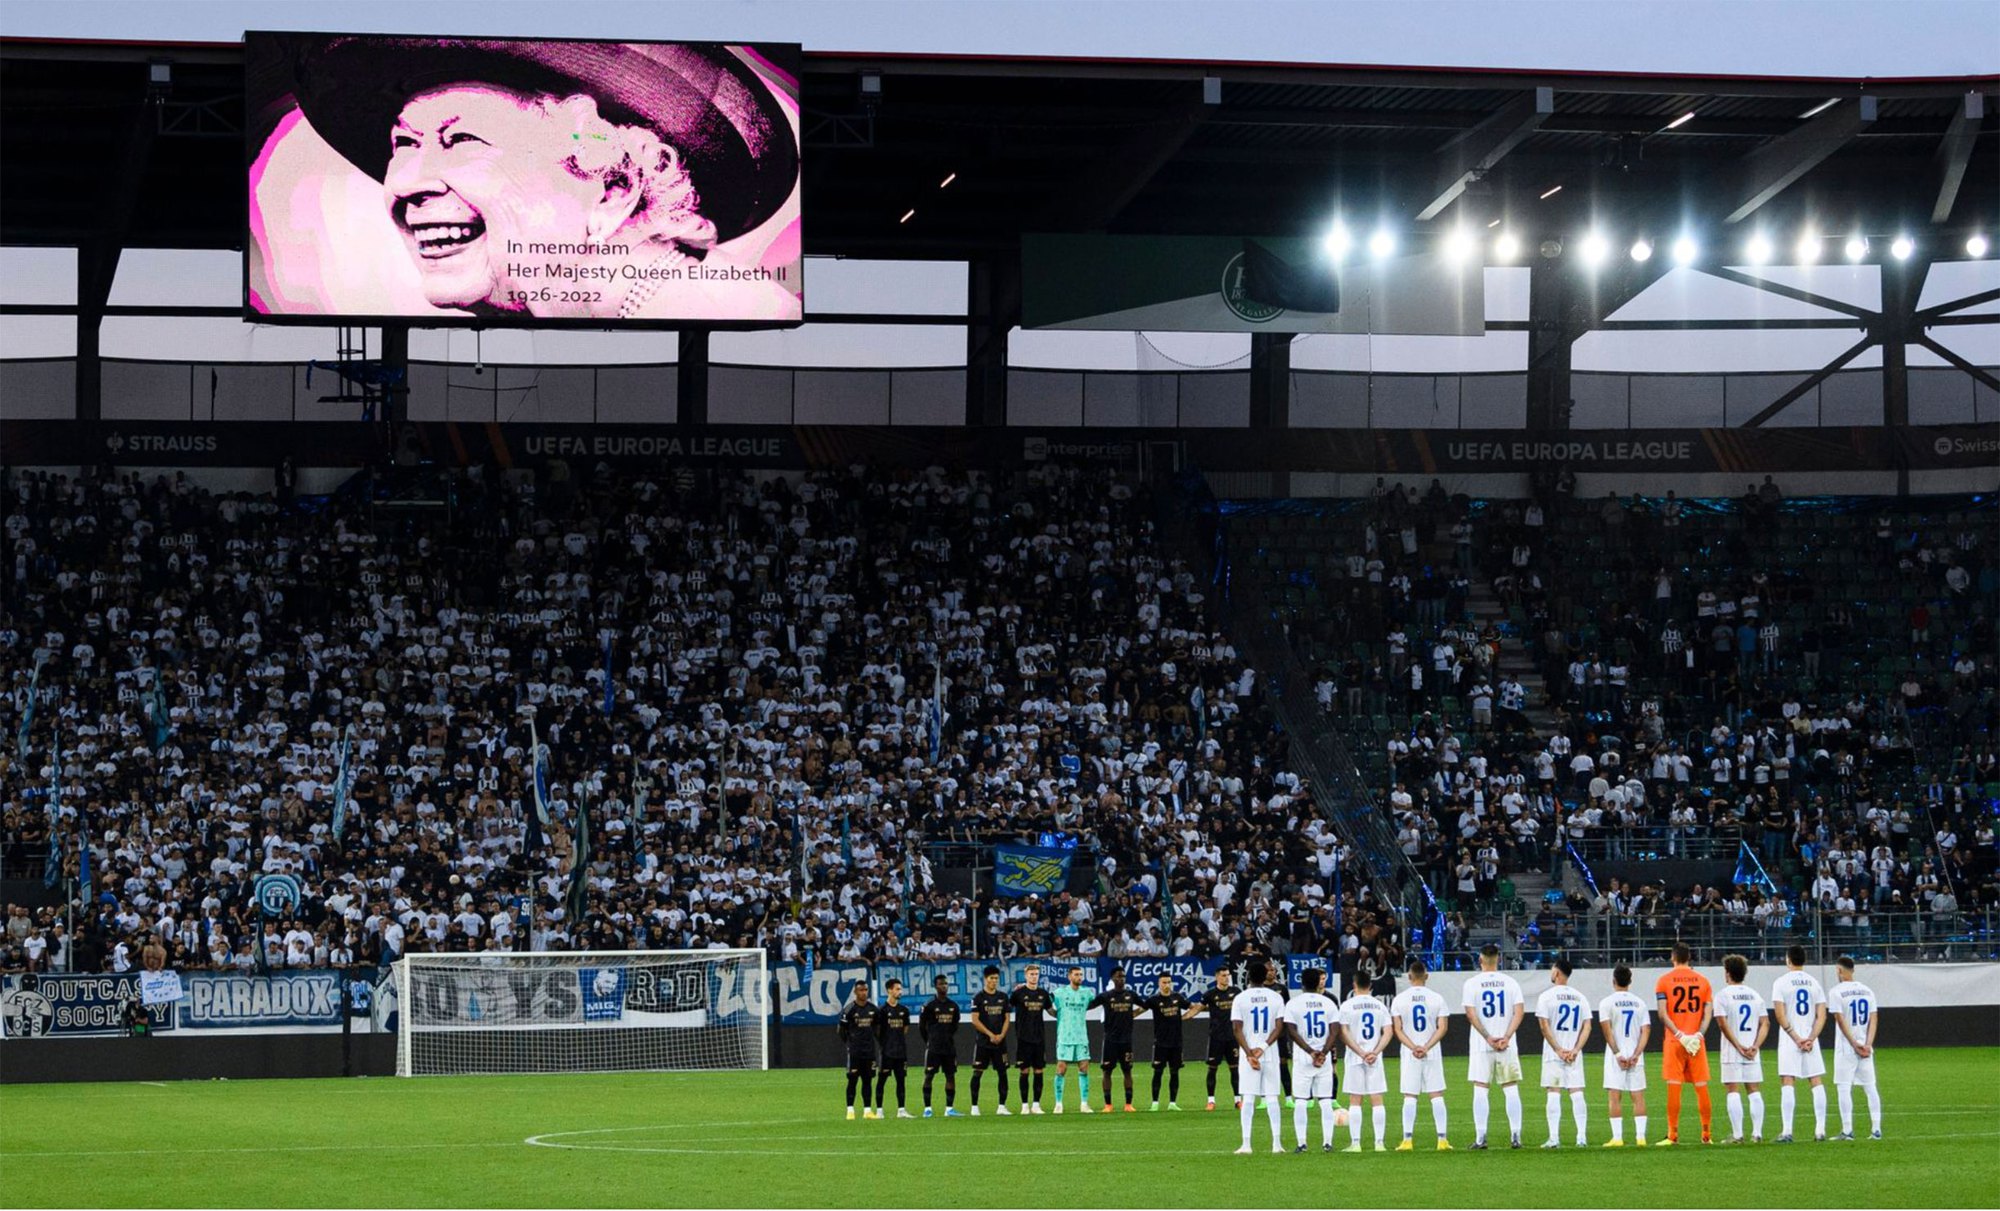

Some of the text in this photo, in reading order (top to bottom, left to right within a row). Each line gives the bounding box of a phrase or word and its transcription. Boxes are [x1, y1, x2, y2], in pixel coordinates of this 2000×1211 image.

[507, 239, 629, 255] In memoriam
[507, 263, 787, 283] Her Majesty Queen Elizabeth II
[507, 287, 602, 303] 1926-2022
[129, 435, 217, 451] STRAUSS
[525, 436, 781, 456] UEFA EUROPA LEAGUE
[1030, 440, 1133, 458] enterprise
[1447, 441, 1690, 460] UEFA EUROPA LEAGUE
[1954, 437, 2000, 453] Swiss
[1291, 957, 1328, 970] FREE
[15, 995, 43, 1011] FCZ
[191, 977, 334, 1019] PARADOX
[1482, 990, 1505, 1018] 31
[1672, 985, 1700, 1013] 25
[1796, 988, 1809, 1017] 8
[14, 1018, 41, 1033] OCS
[57, 1002, 169, 1026] SOCIY
[1250, 1006, 1269, 1034] 11
[1303, 1010, 1326, 1039] 15
[1412, 1004, 1427, 1033] 6
[1556, 1003, 1580, 1032] 21
[1621, 1010, 1634, 1038] 7
[1738, 1003, 1752, 1032] 2
[1849, 998, 1869, 1027] 19
[1361, 1012, 1375, 1040] 3
